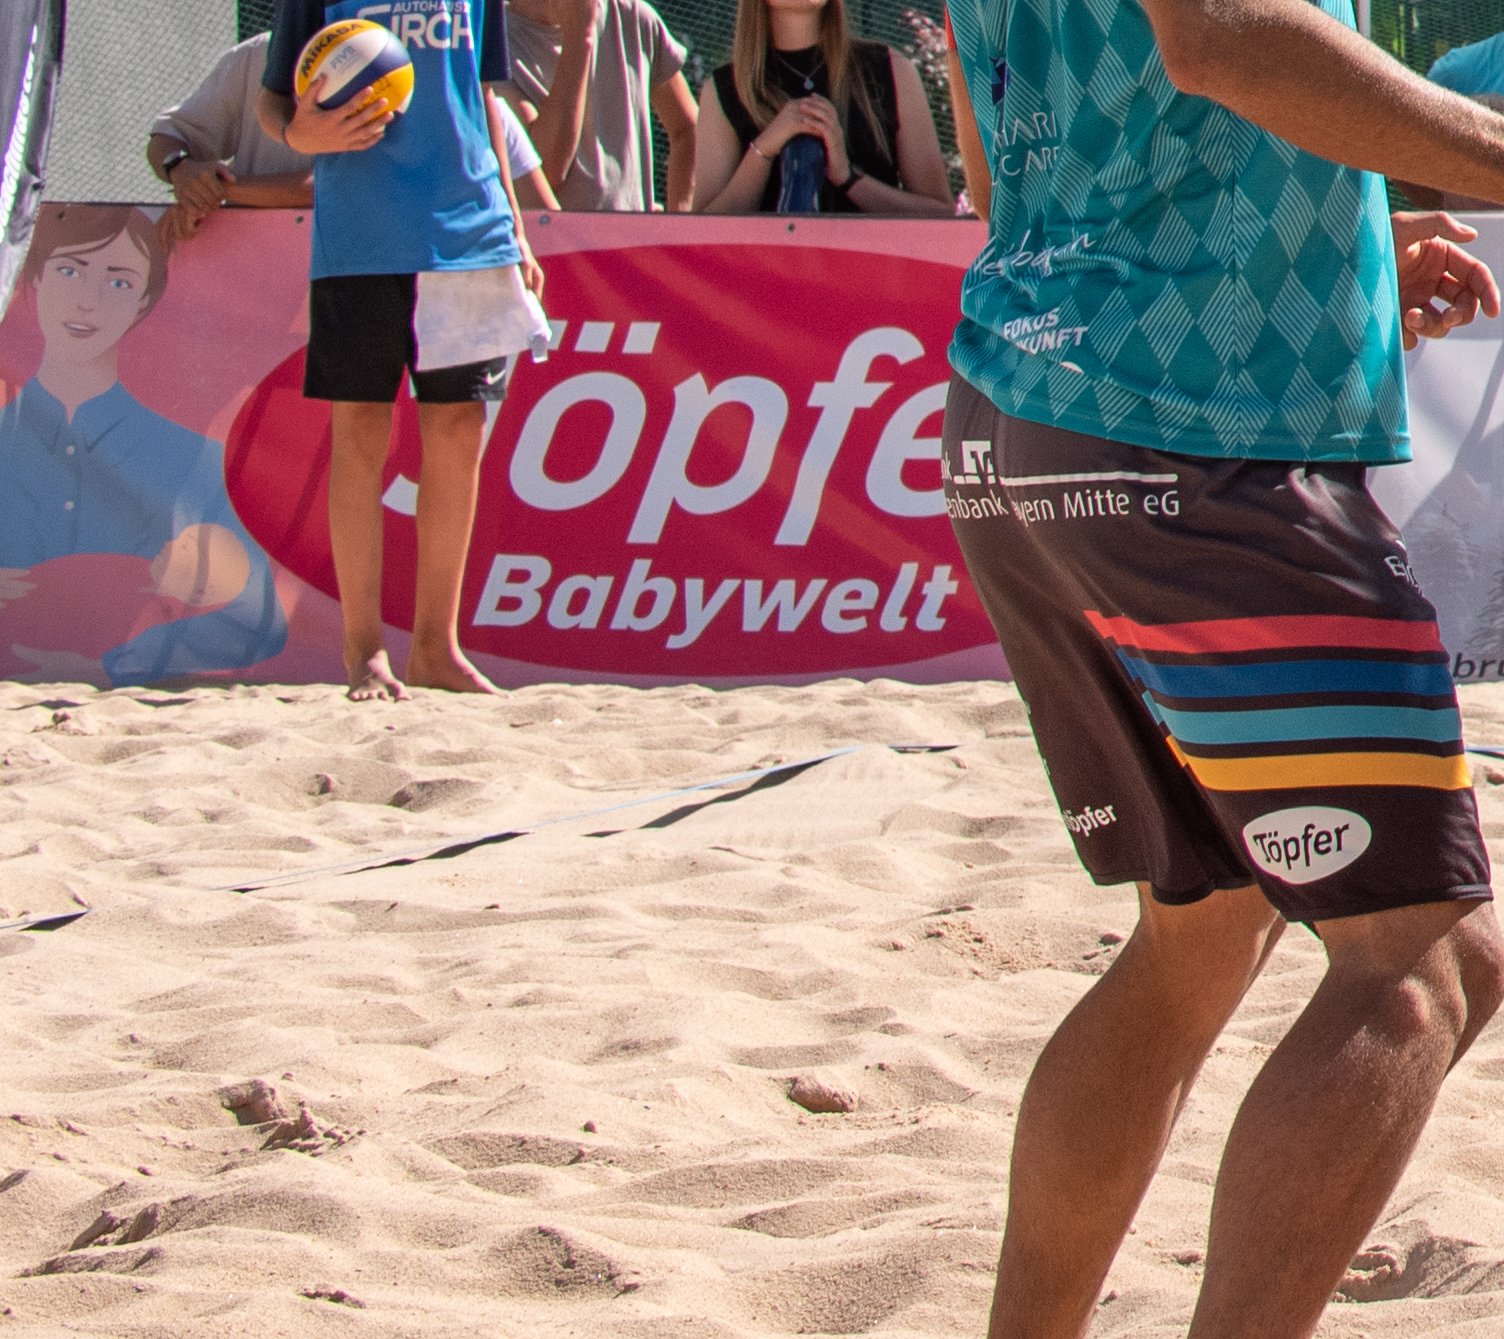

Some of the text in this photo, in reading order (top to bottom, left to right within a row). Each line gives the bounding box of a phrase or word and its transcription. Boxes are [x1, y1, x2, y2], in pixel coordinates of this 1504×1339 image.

[301, 22, 365, 79] MIKASA
[1002, 307, 1062, 345] FOKUS
[1063, 486, 1130, 518] Mitte
[1142, 487, 1181, 517] eG
[472, 552, 959, 650] Babywelt
[1252, 819, 1351, 872] Töpfer
